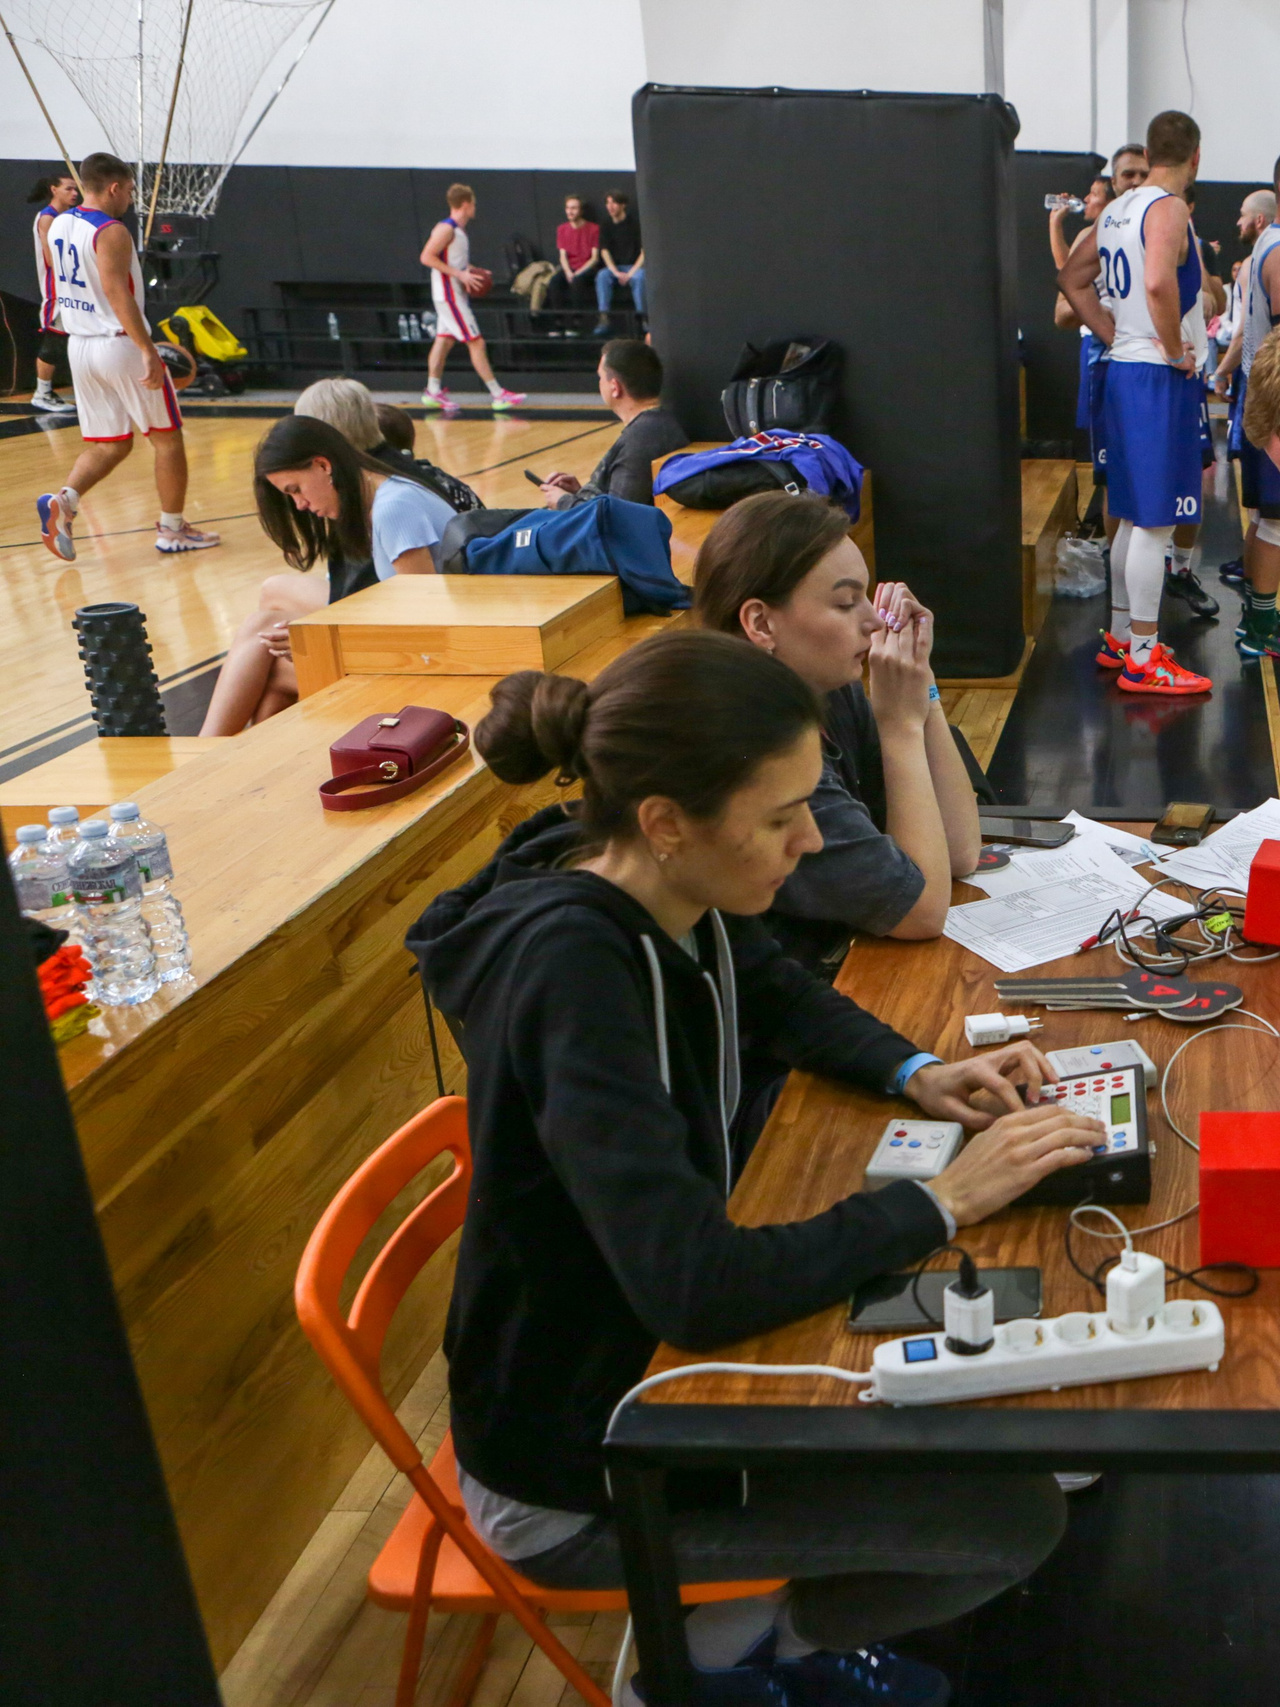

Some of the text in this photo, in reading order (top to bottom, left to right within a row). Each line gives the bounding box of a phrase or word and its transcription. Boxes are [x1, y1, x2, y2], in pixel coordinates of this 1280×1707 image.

[54, 239, 86, 288] 12
[1099, 246, 1131, 300] 20
[1175, 496, 1197, 517] 20
